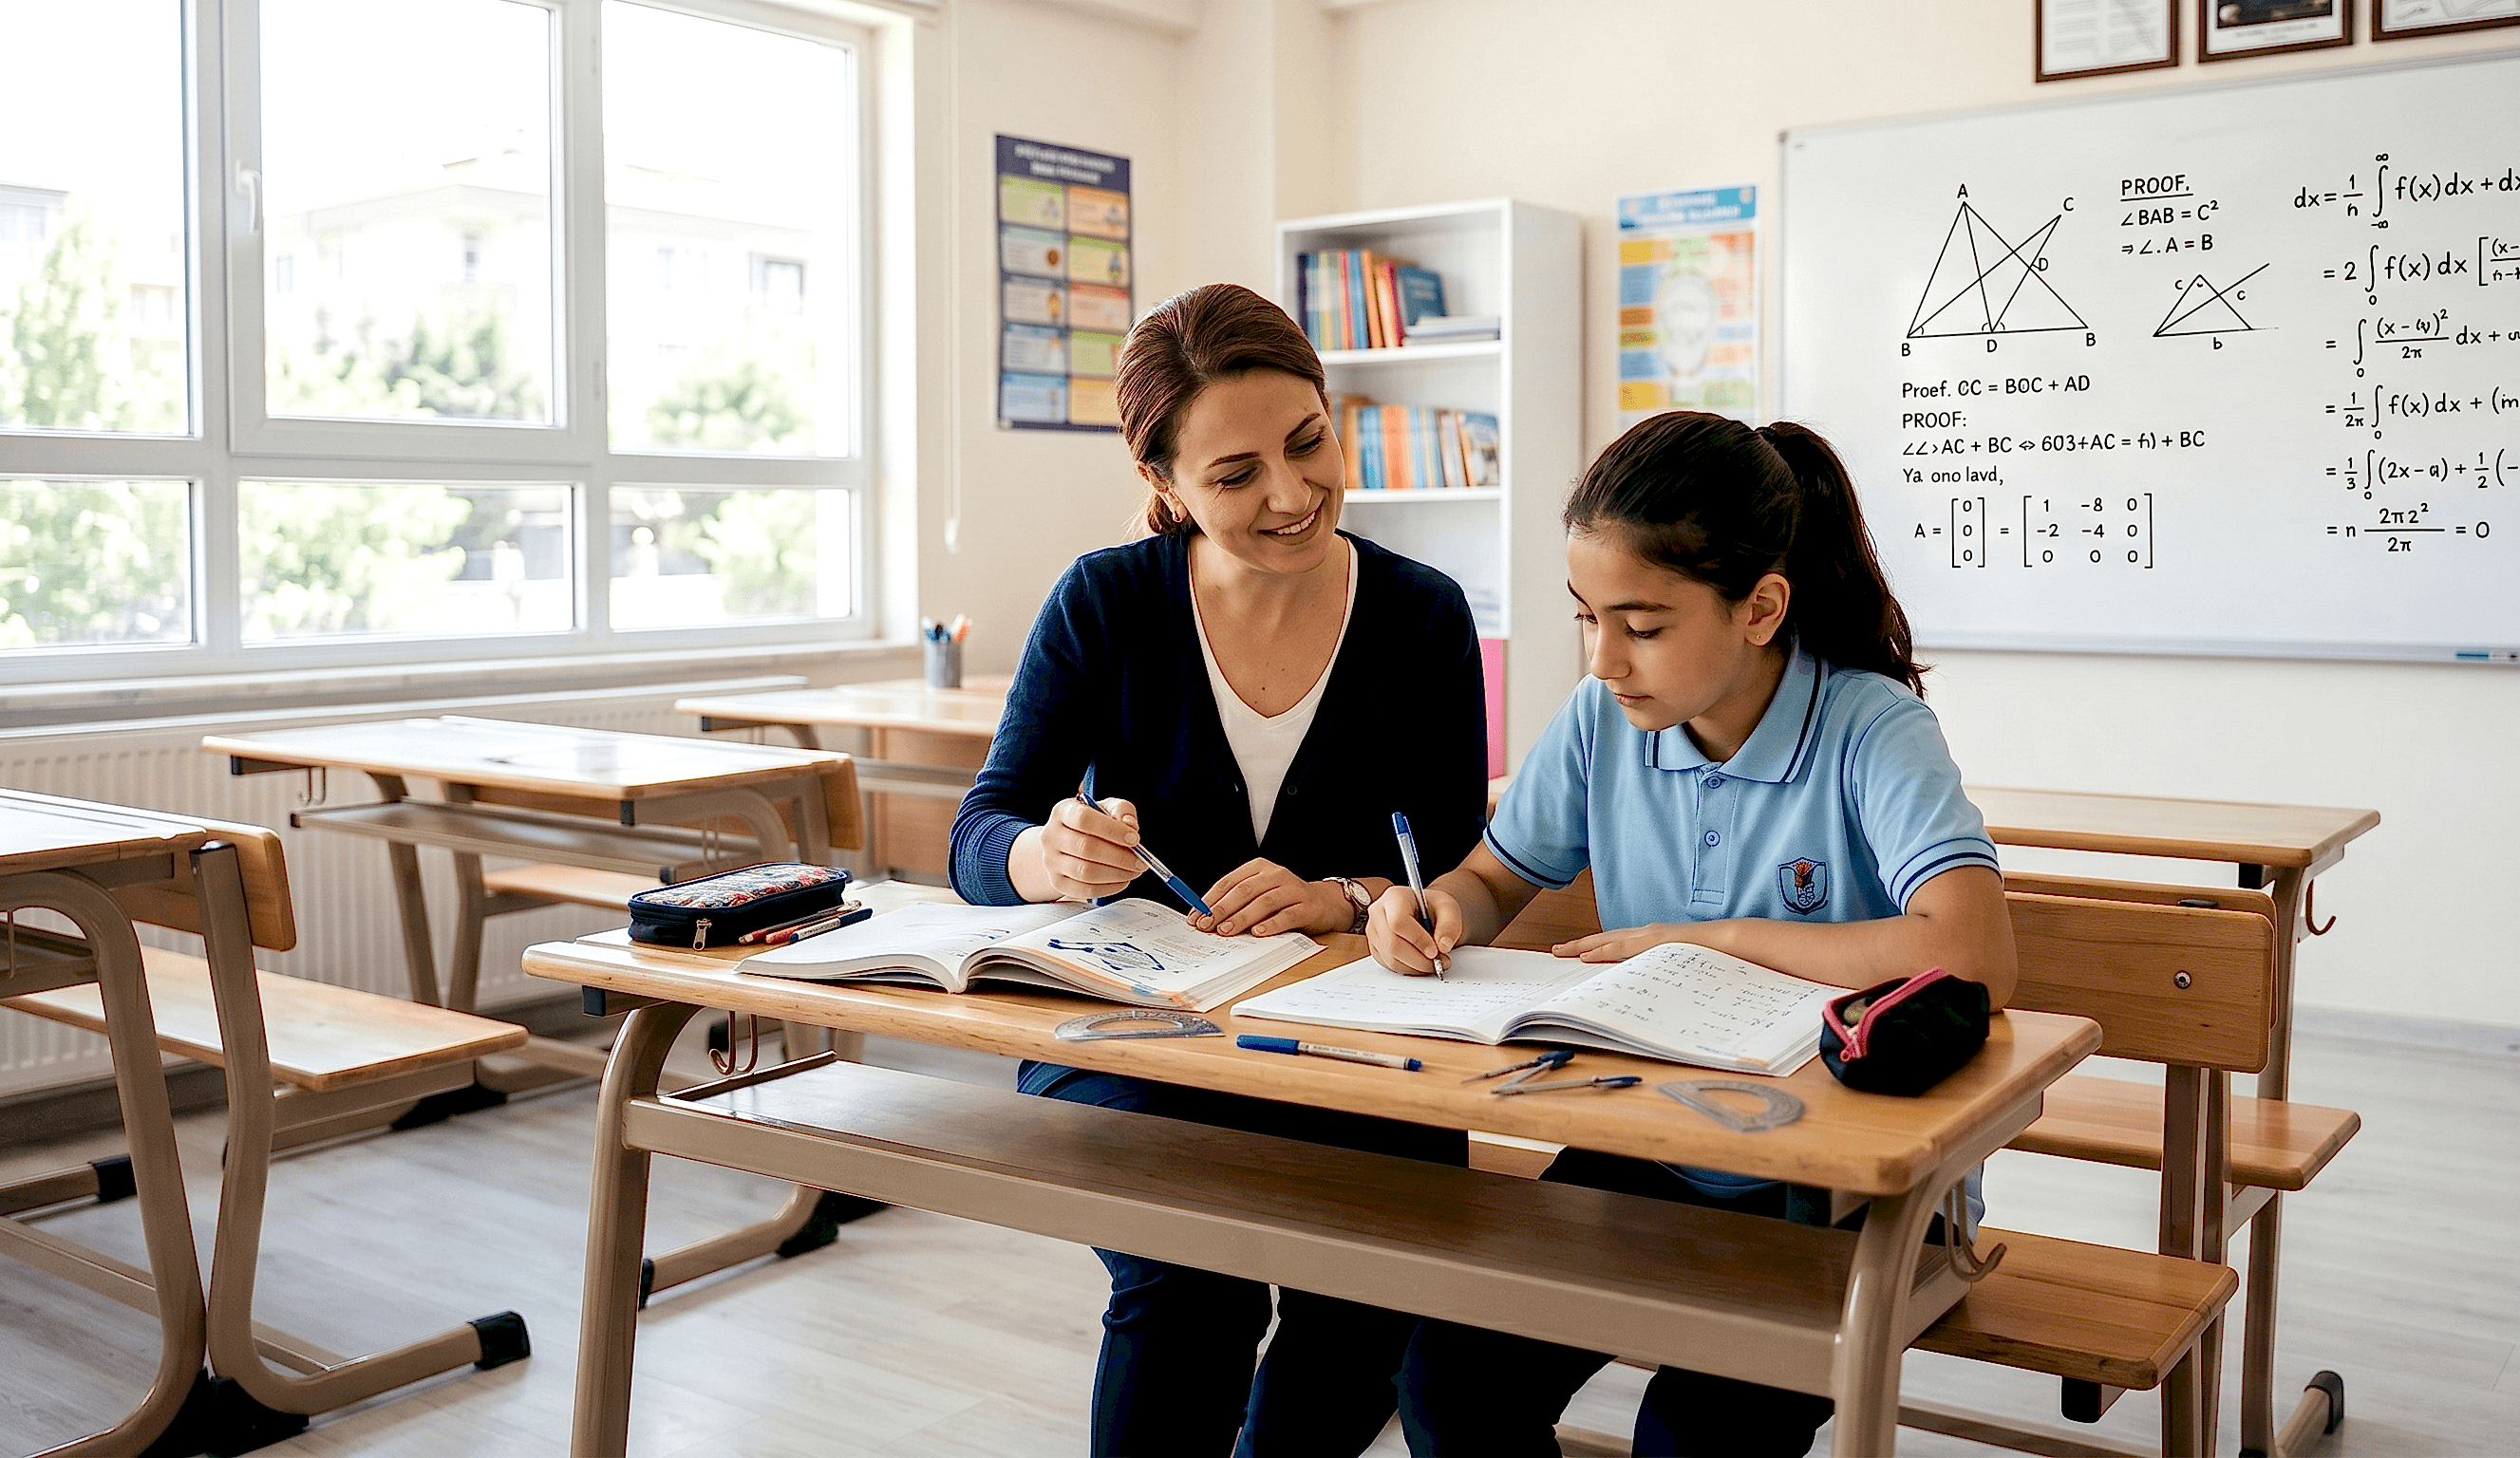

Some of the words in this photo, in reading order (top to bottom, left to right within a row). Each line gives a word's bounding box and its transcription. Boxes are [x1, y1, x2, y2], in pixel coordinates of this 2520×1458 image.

[1956, 182, 1969, 199] A
[2121, 174, 2190, 196] PROOF.
[2062, 196, 2075, 212] C
[2201, 234, 2213, 252] B
[2038, 257, 2049, 272] D
[2343, 261, 2358, 281] 2
[2085, 331, 2097, 347] B
[2212, 336, 2224, 350] b
[2455, 325, 2482, 346] dx
[1901, 342, 1911, 358] B
[1986, 338, 1998, 353] D
[2063, 374, 2091, 393] AD
[1902, 410, 1967, 430] PROOF:
[1988, 436, 2013, 454] BC
[2179, 430, 2206, 448] BC
[1902, 467, 1924, 483] Ya
[1930, 471, 1962, 483] ono
[2477, 475, 2489, 489] 2
[2346, 477, 2357, 491] 3
[2042, 498, 2049, 513] 1
[1913, 522, 1927, 539] A
